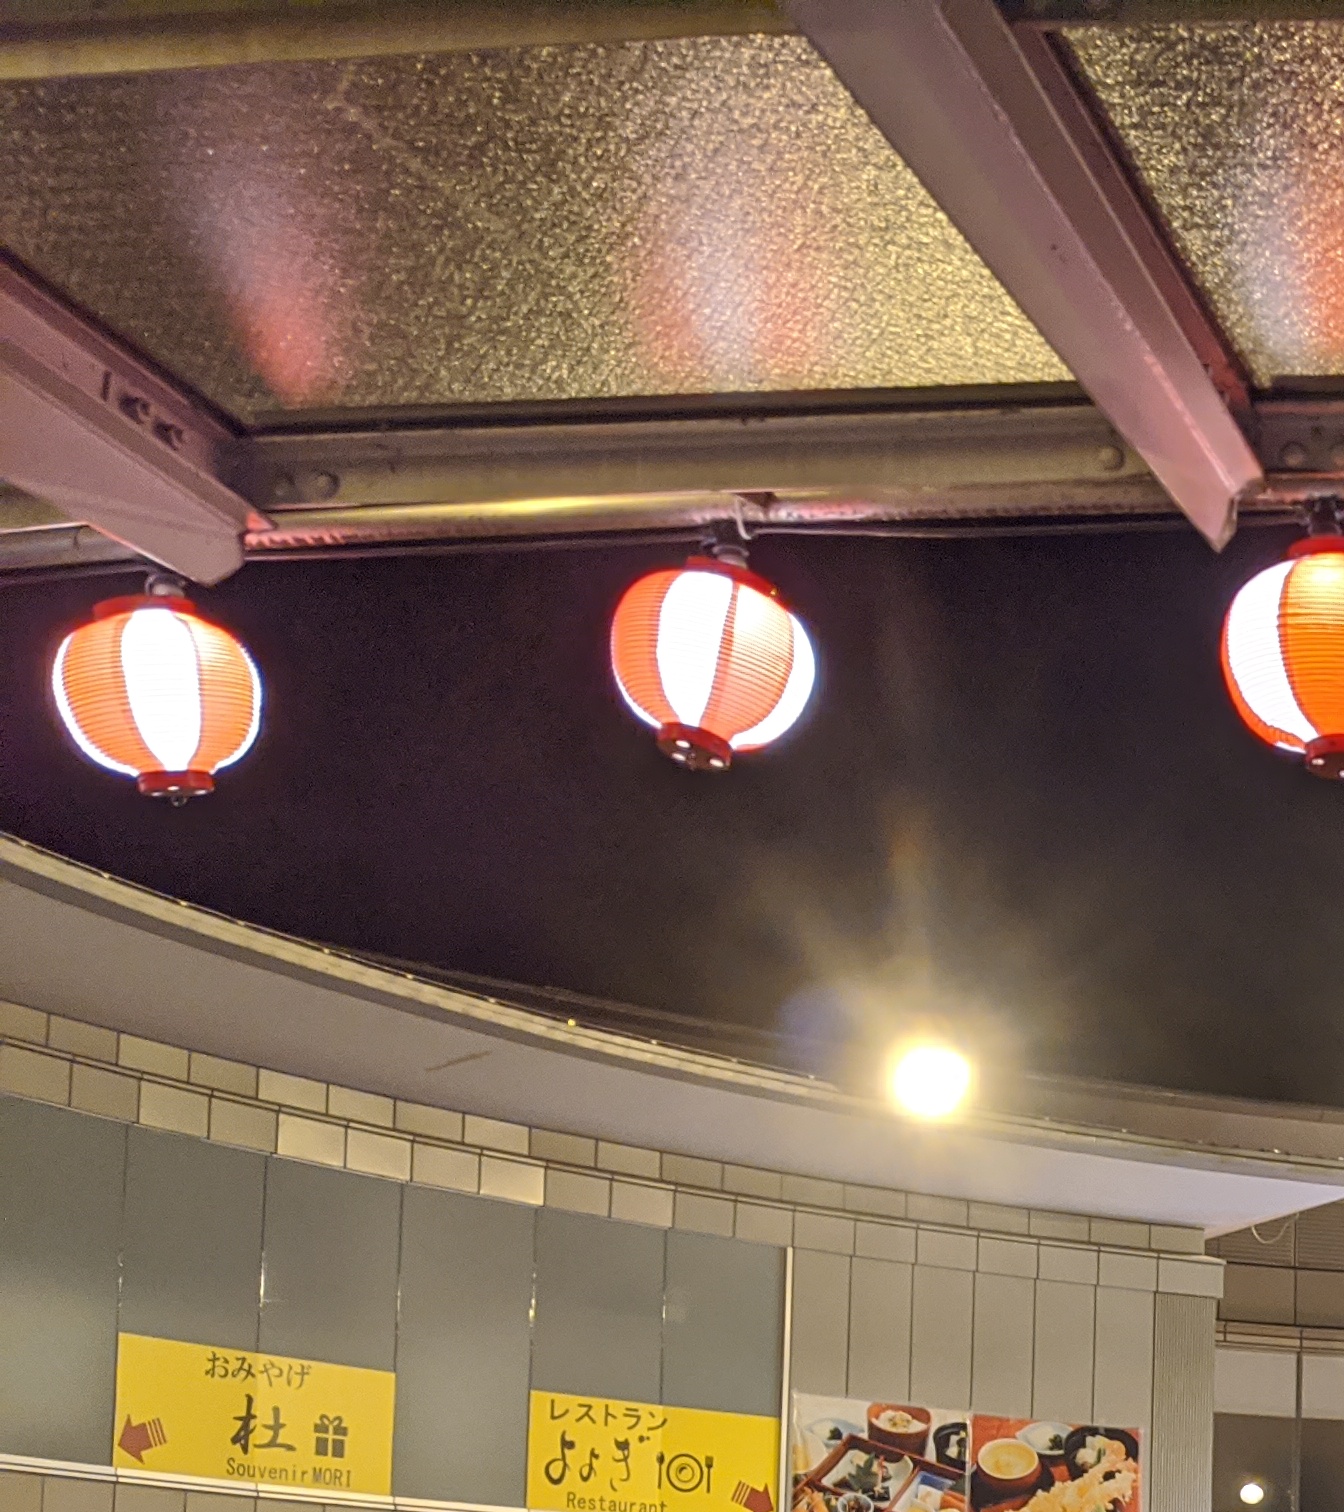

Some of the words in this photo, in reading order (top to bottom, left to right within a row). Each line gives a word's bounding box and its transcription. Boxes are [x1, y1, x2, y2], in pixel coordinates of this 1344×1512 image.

[204, 1350, 312, 1391] おみやげ
[229, 1393, 297, 1456] 杜
[549, 1398, 669, 1432] レストラン
